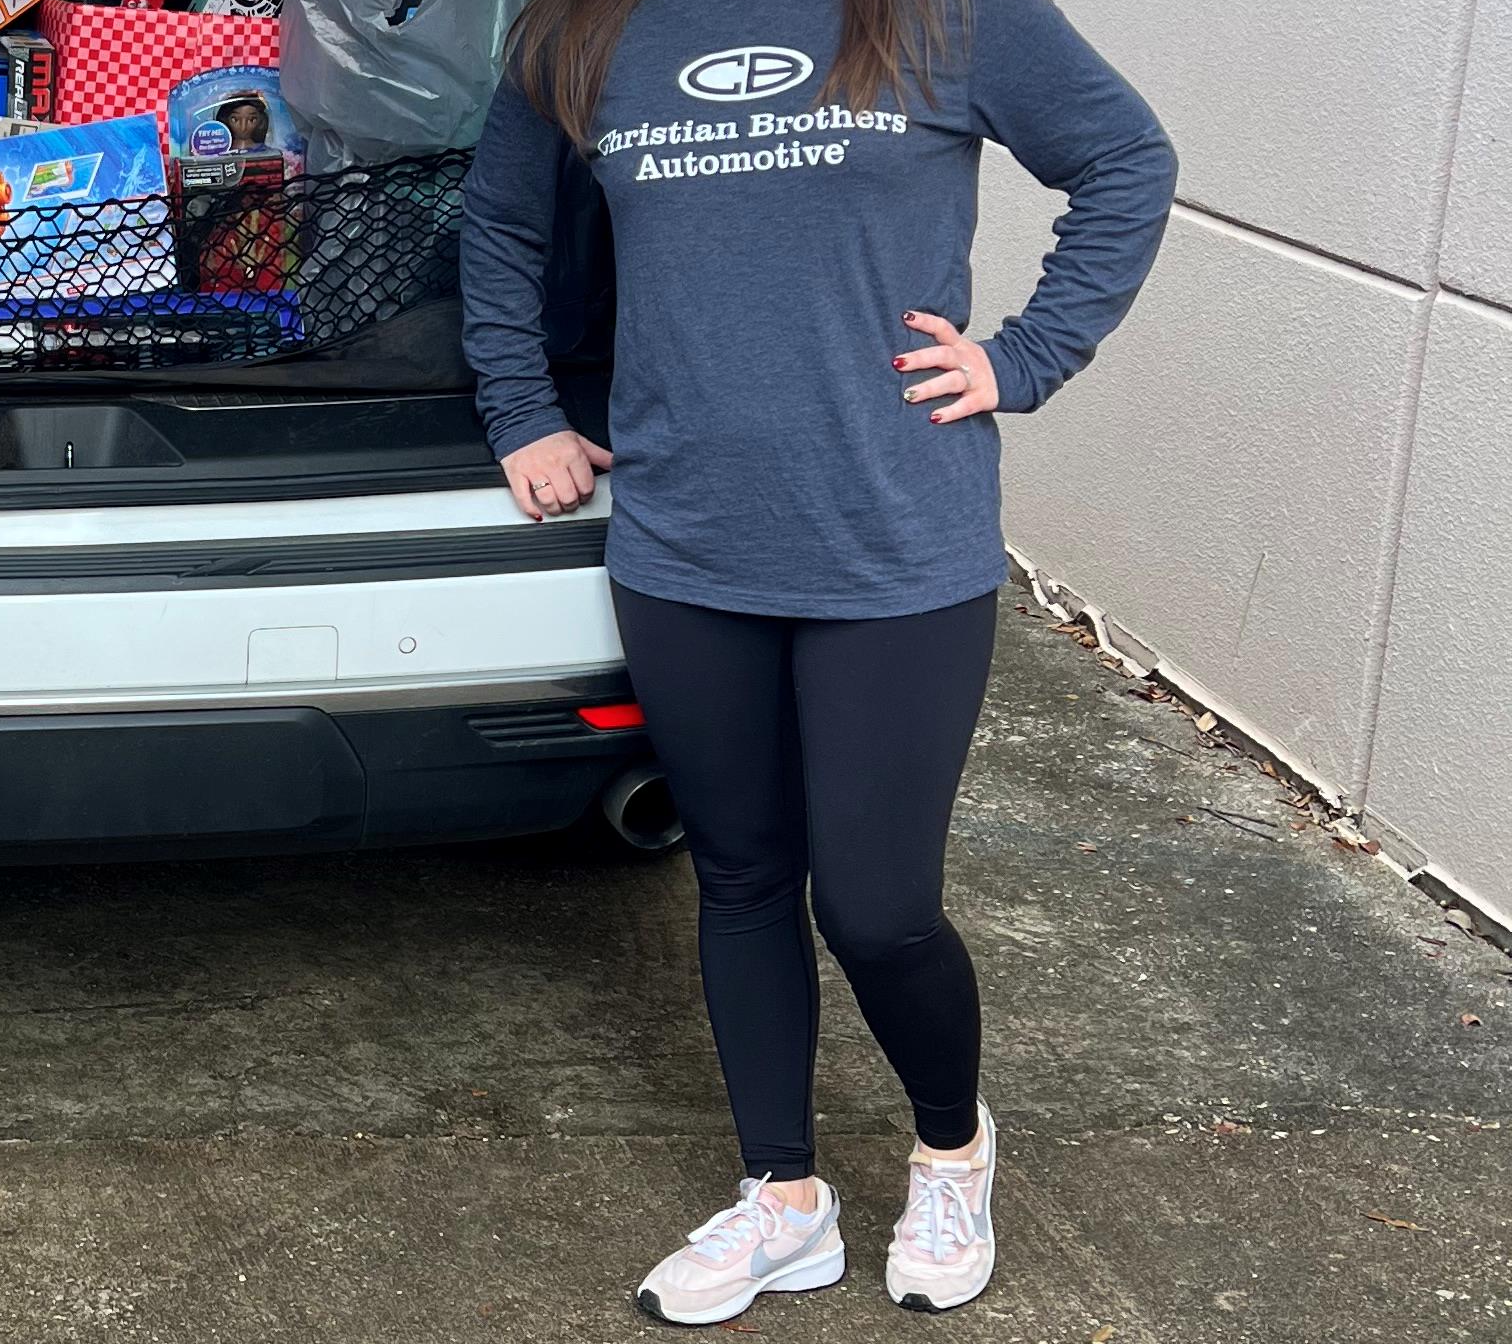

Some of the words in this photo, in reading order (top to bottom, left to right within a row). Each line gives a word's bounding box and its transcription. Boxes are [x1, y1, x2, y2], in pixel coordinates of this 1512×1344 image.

[32, 53, 52, 121] MA
[597, 119, 739, 156] Christian
[748, 105, 908, 138] Brothers
[636, 139, 846, 180] Automotive
